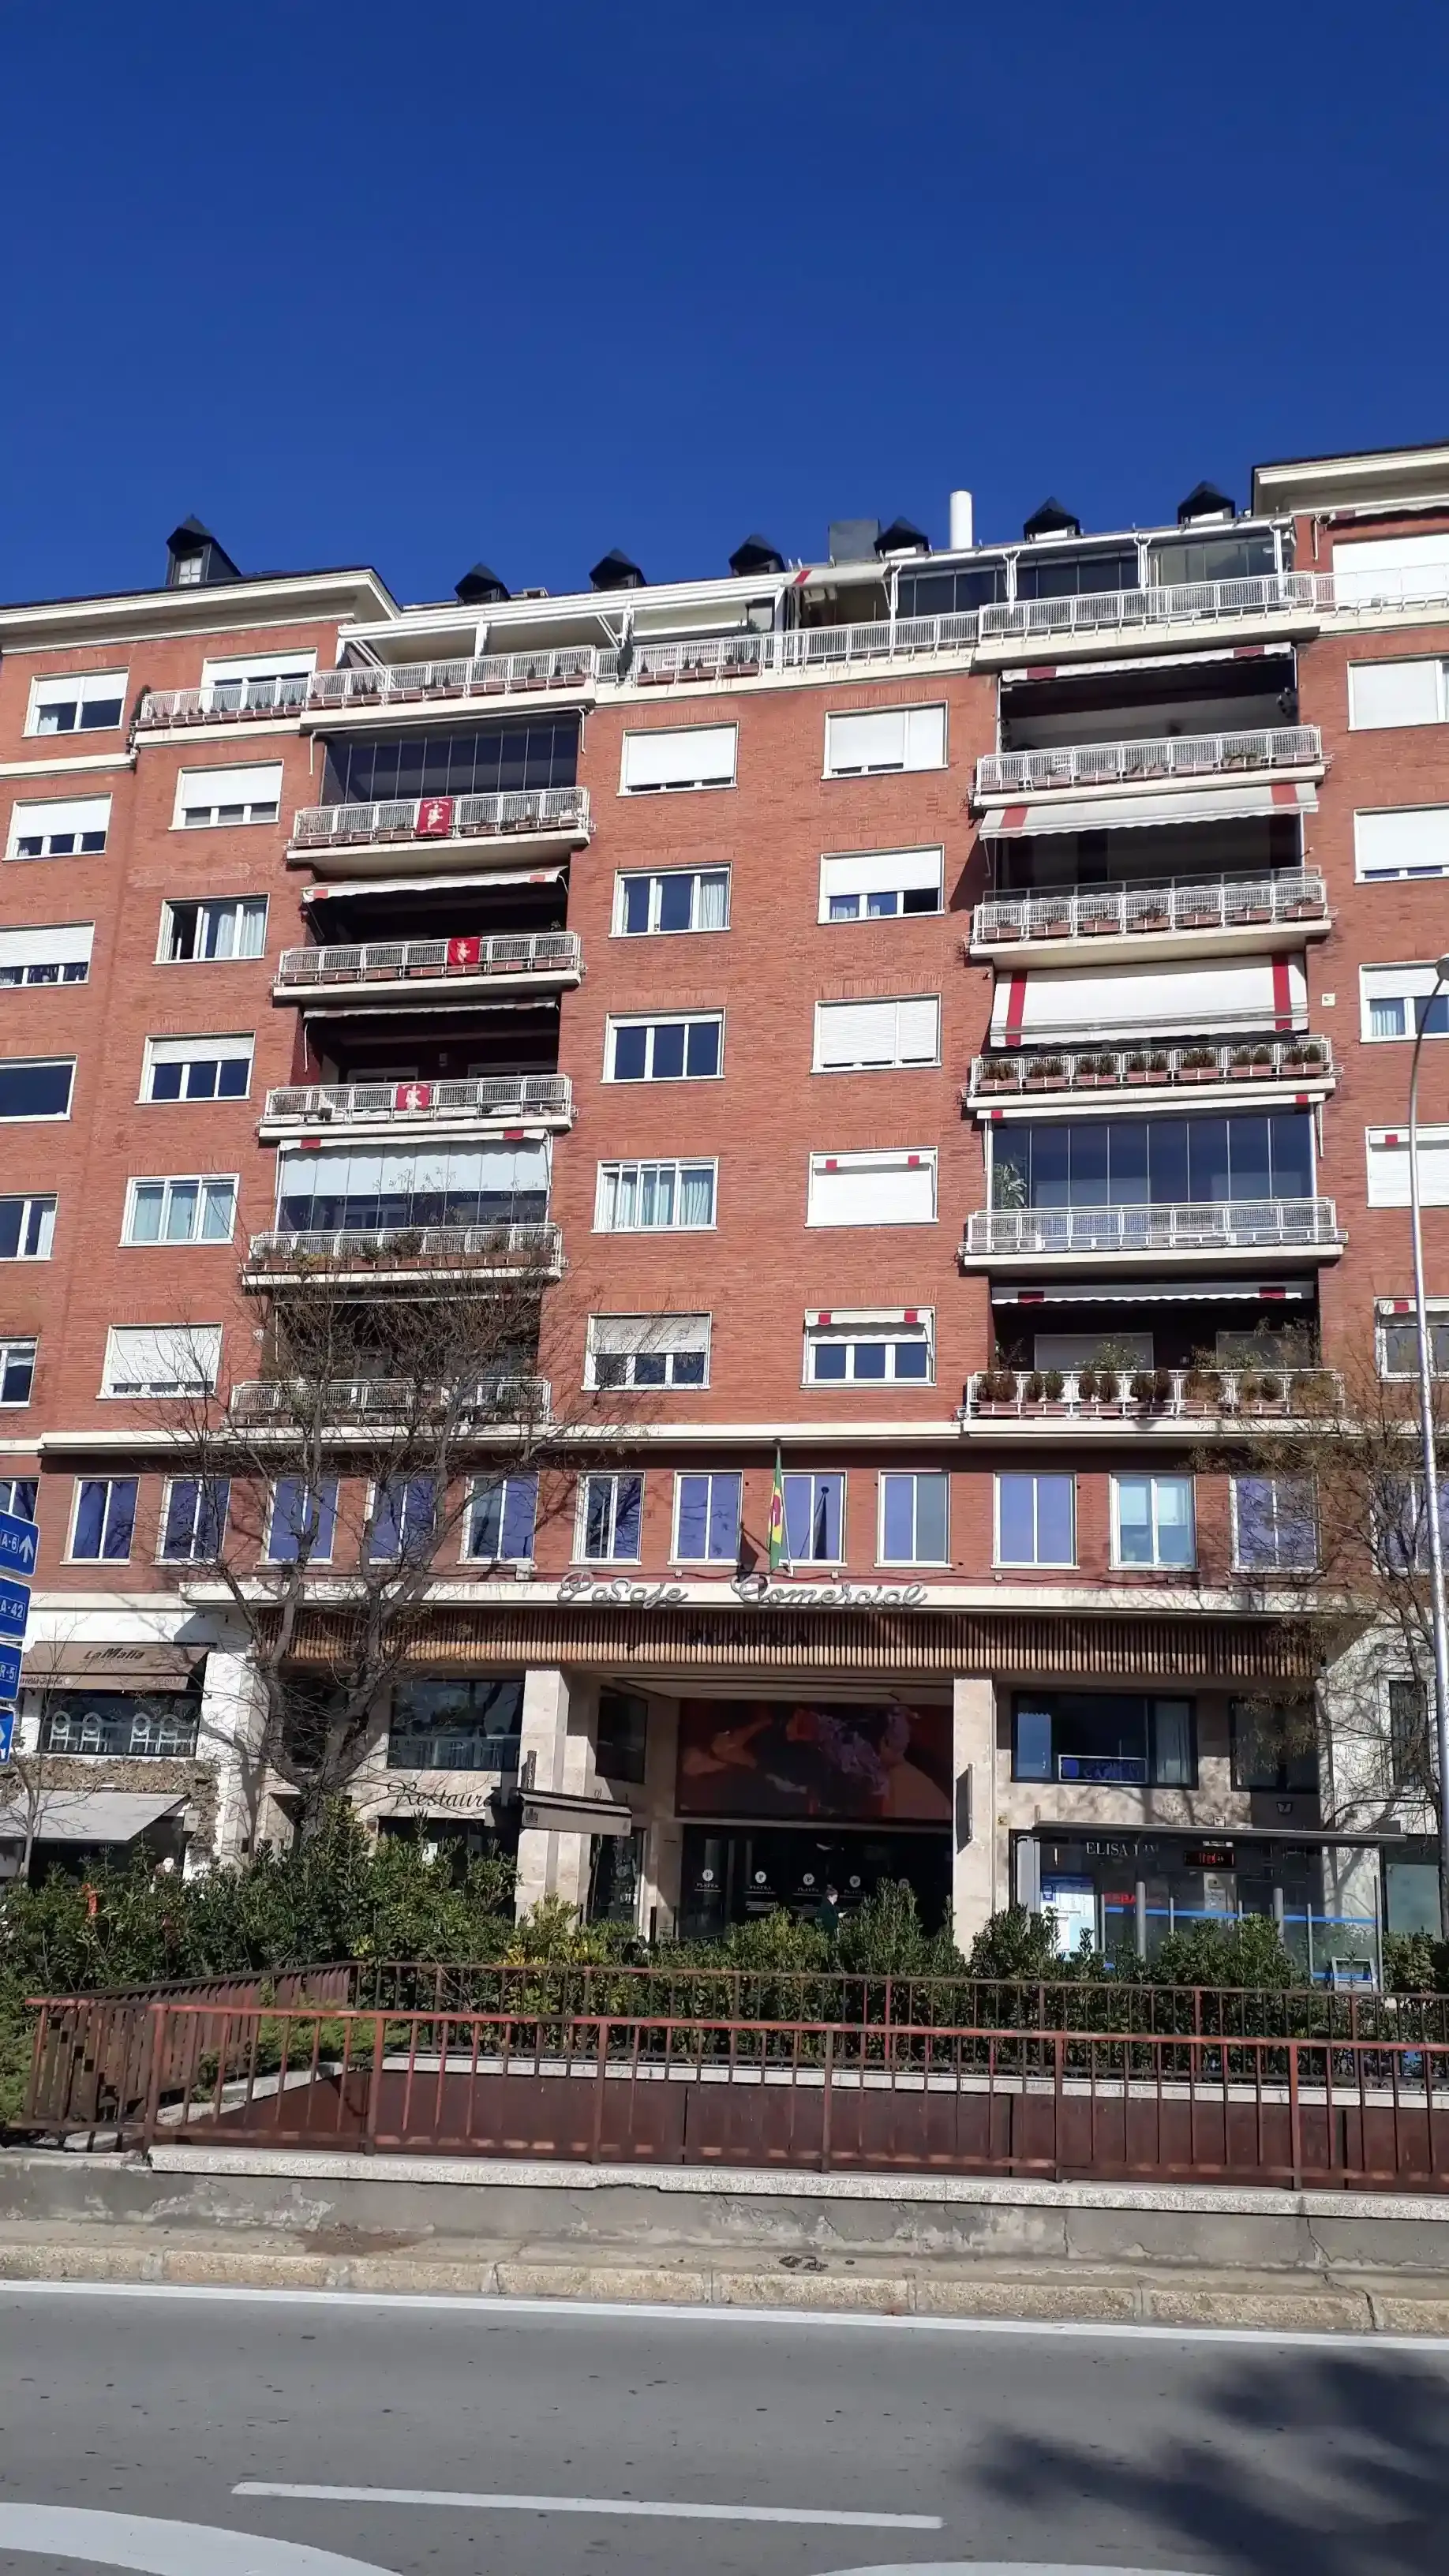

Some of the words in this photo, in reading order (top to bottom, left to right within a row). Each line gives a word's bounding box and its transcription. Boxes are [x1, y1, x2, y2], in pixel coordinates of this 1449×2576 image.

[2, 1533, 17, 1551] A-6
[730, 1573, 928, 1606] Comercial
[0, 1599, 24, 1618] A-42
[0, 1664, 15, 1679] R-5
[1086, 1841, 1128, 1857] ELISA
